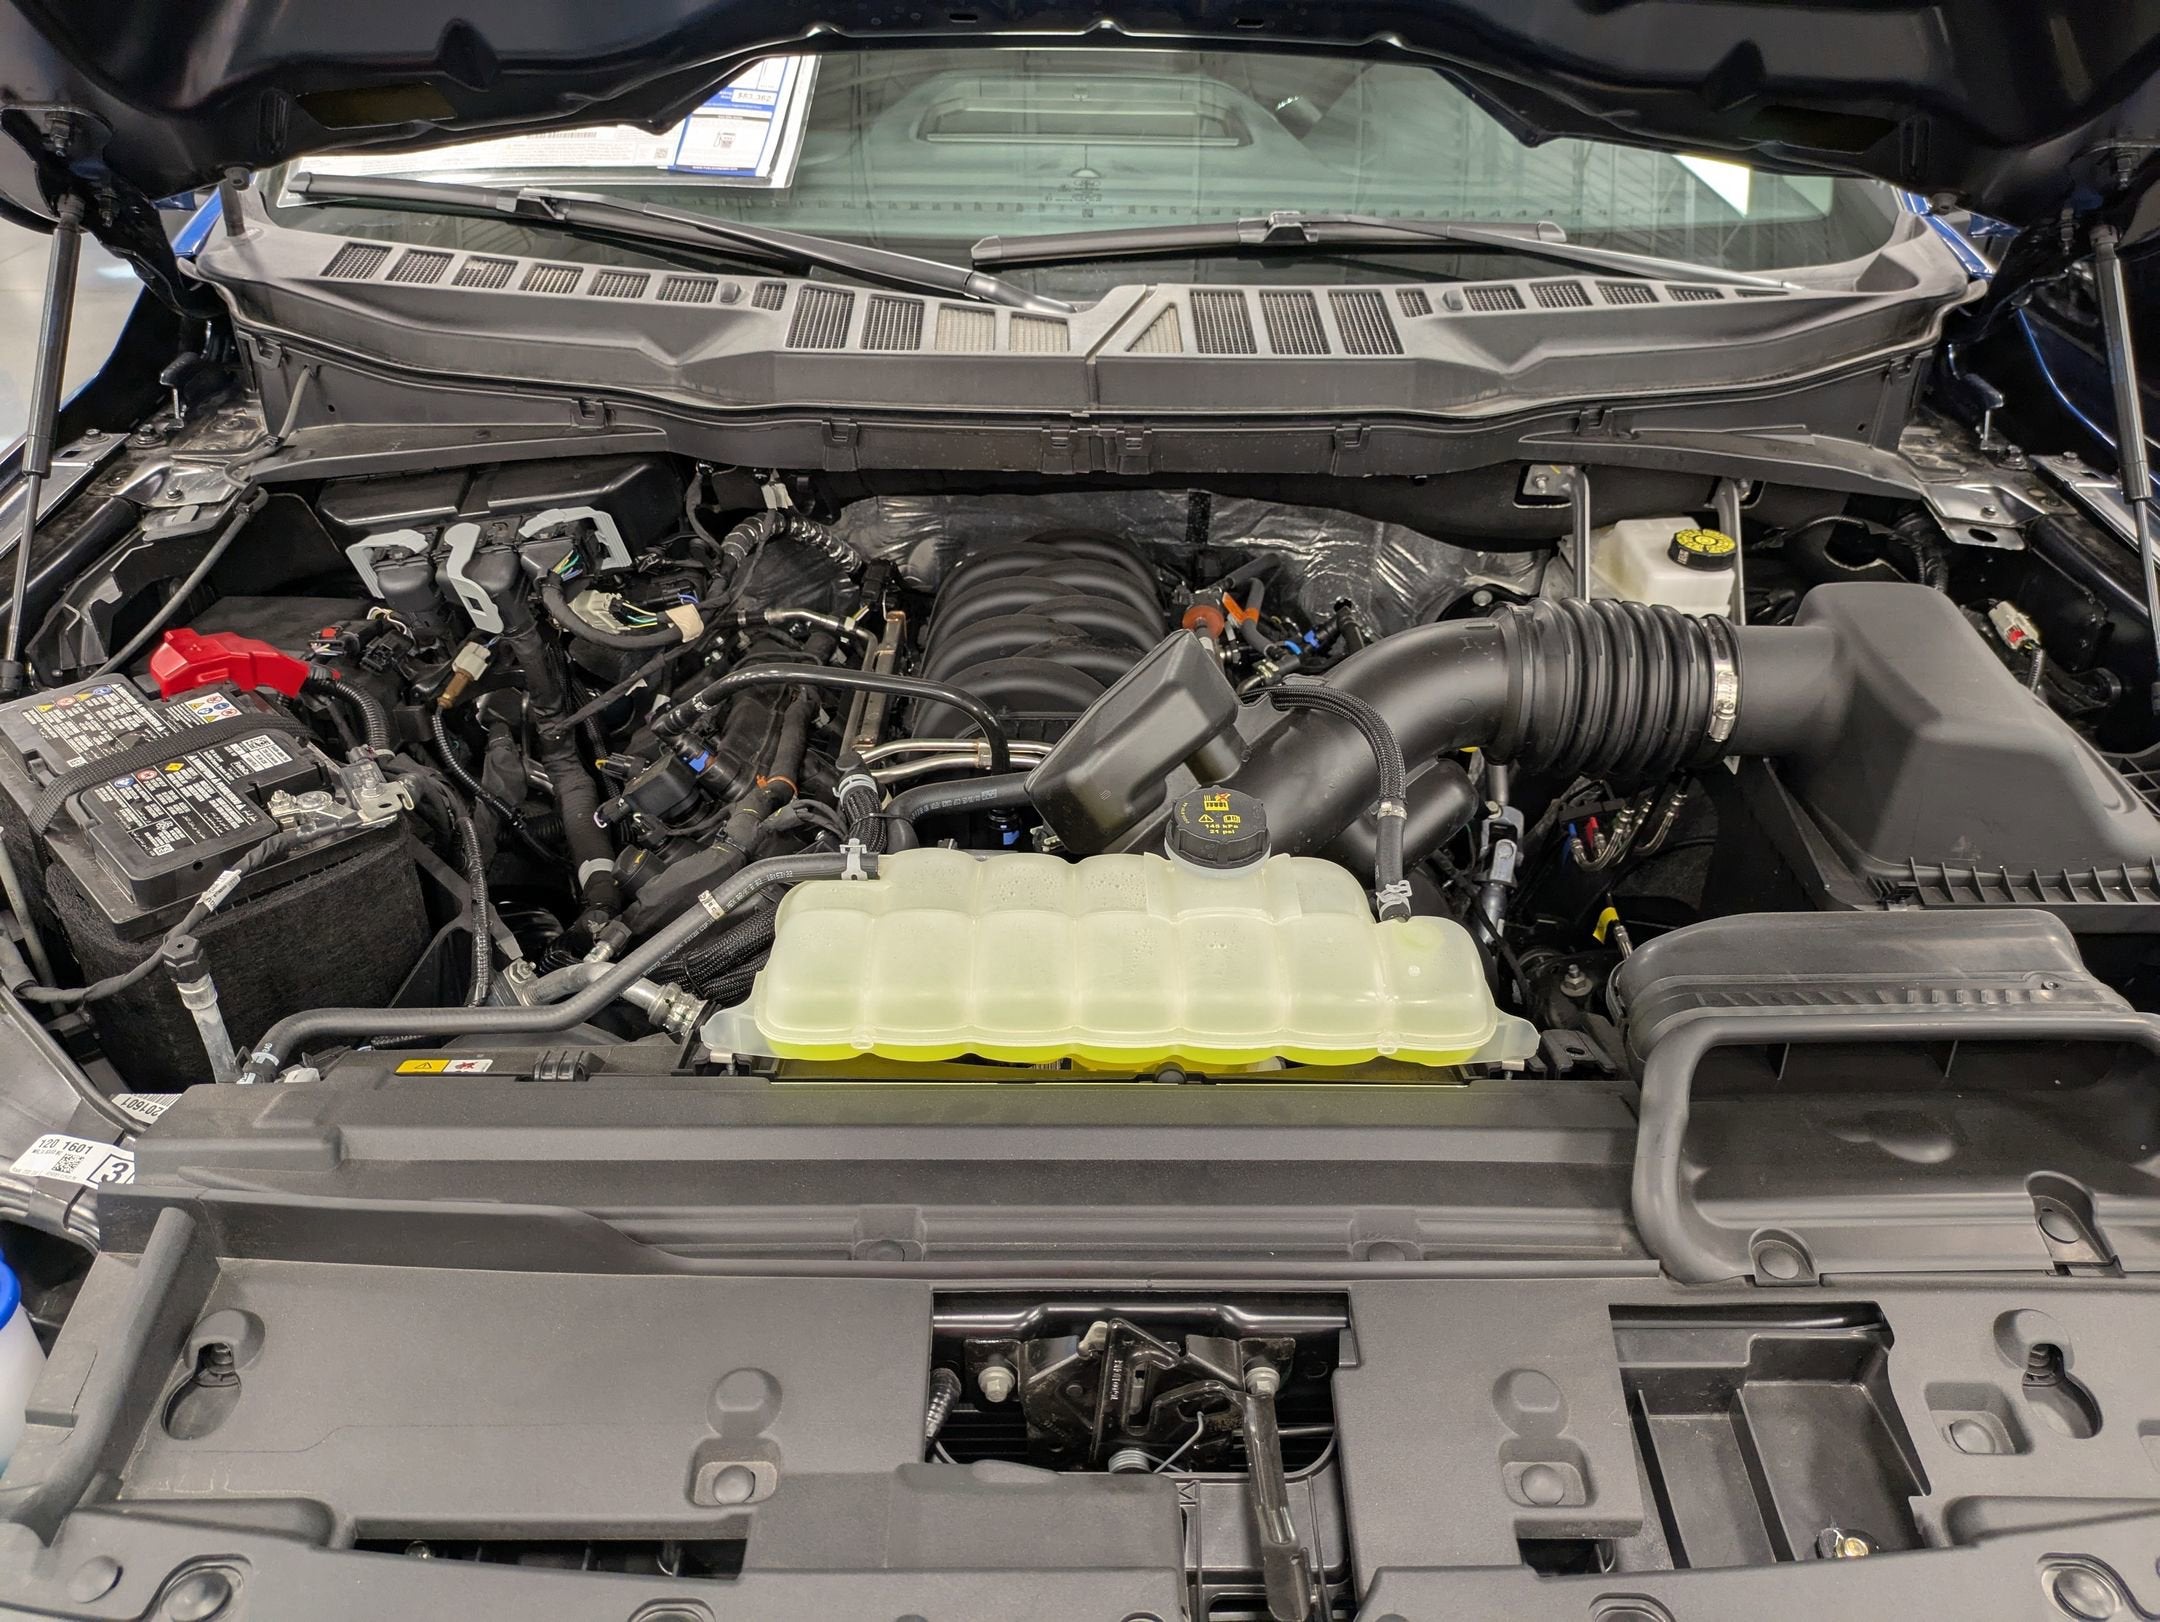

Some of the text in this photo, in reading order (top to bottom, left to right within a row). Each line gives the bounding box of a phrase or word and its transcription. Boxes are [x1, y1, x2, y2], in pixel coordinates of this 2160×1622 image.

[120, 1097, 164, 1117] 201601
[38, 1139, 60, 1149] 120
[62, 1141, 93, 1155] 1601
